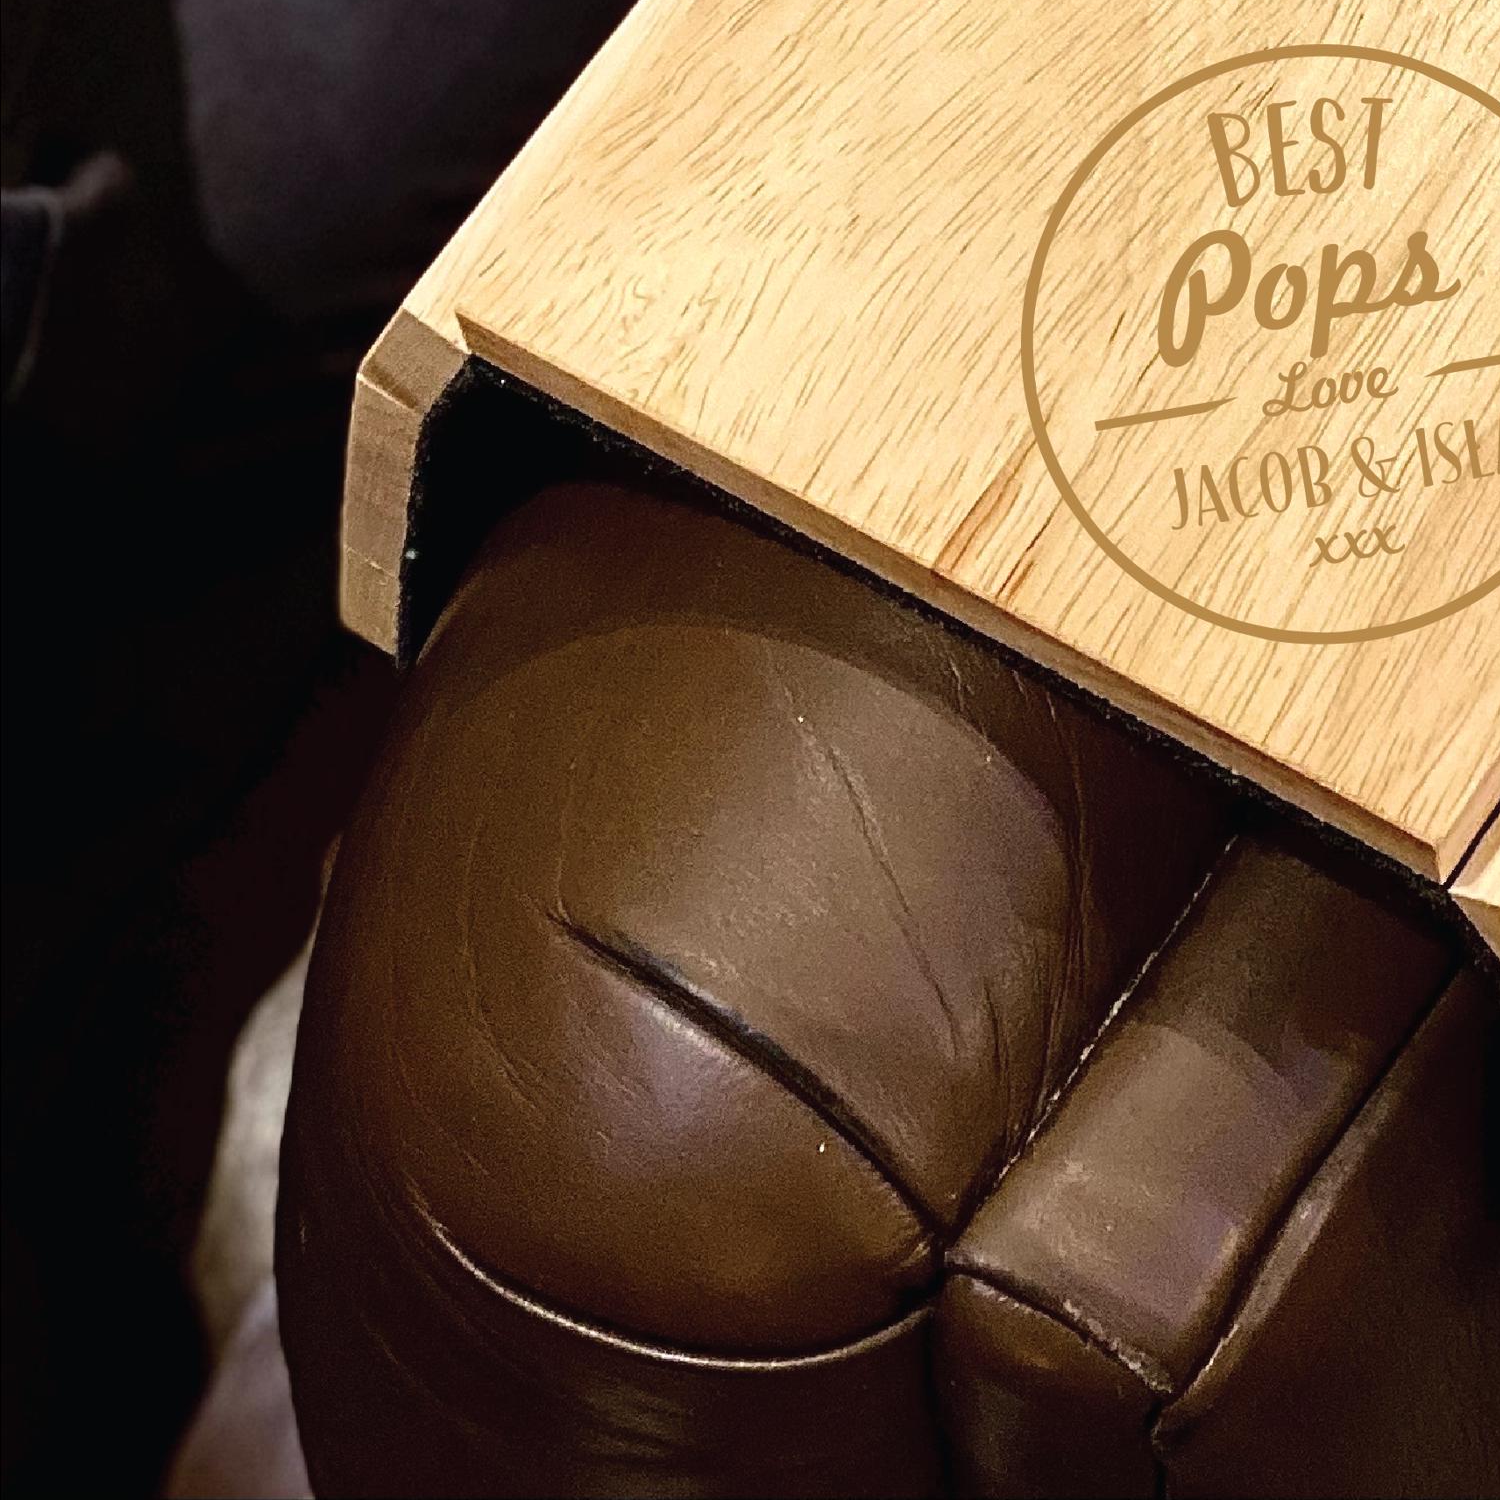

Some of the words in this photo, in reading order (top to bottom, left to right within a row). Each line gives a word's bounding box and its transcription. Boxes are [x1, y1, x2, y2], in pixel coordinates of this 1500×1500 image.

[1207, 97, 1393, 208] BEST
[1157, 229, 1462, 368] Pops
[1262, 361, 1399, 417] Love
[1171, 445, 1333, 531] JACOB
[1350, 436, 1400, 499] &
